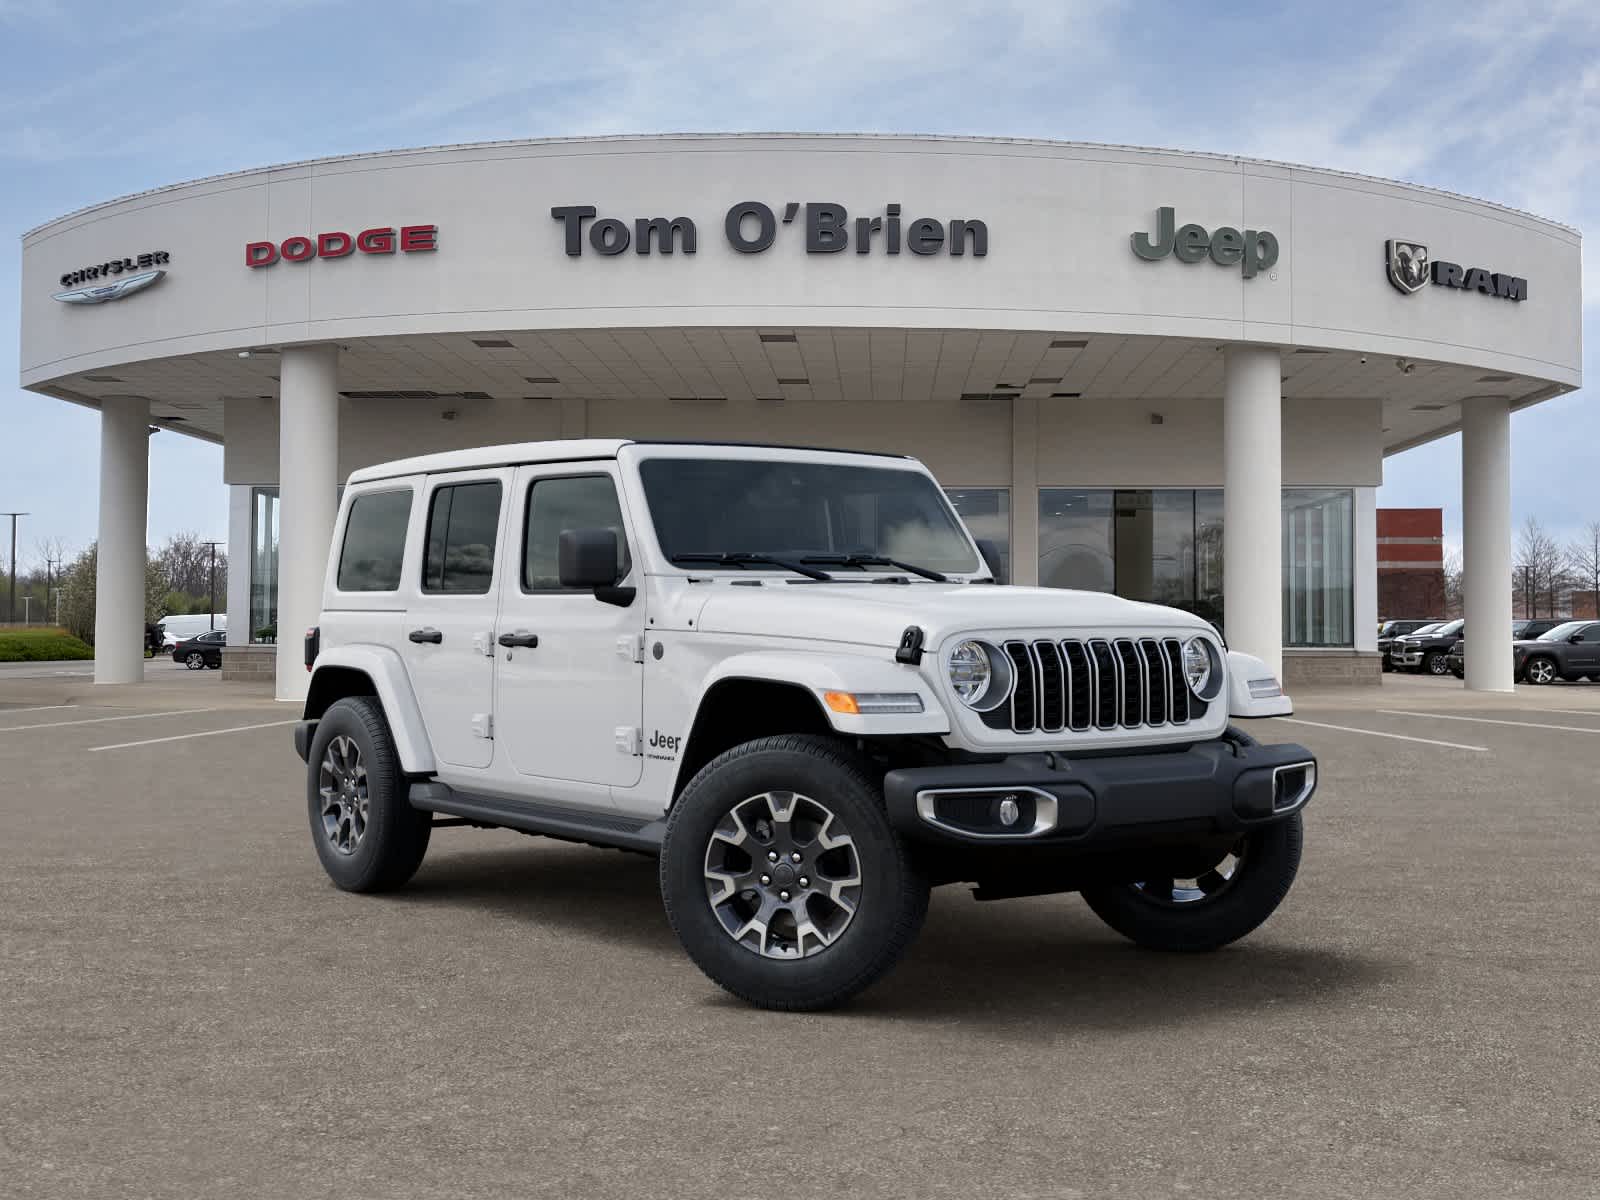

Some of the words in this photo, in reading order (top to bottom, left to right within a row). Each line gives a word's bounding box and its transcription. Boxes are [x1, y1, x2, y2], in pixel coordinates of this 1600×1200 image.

[245, 224, 438, 269] DODGE
[551, 205, 697, 256] Tom
[725, 201, 988, 257] O'Brien
[1130, 207, 1279, 279] Jeep
[61, 252, 170, 286] CHRYSLER
[1432, 261, 1528, 301] RAM
